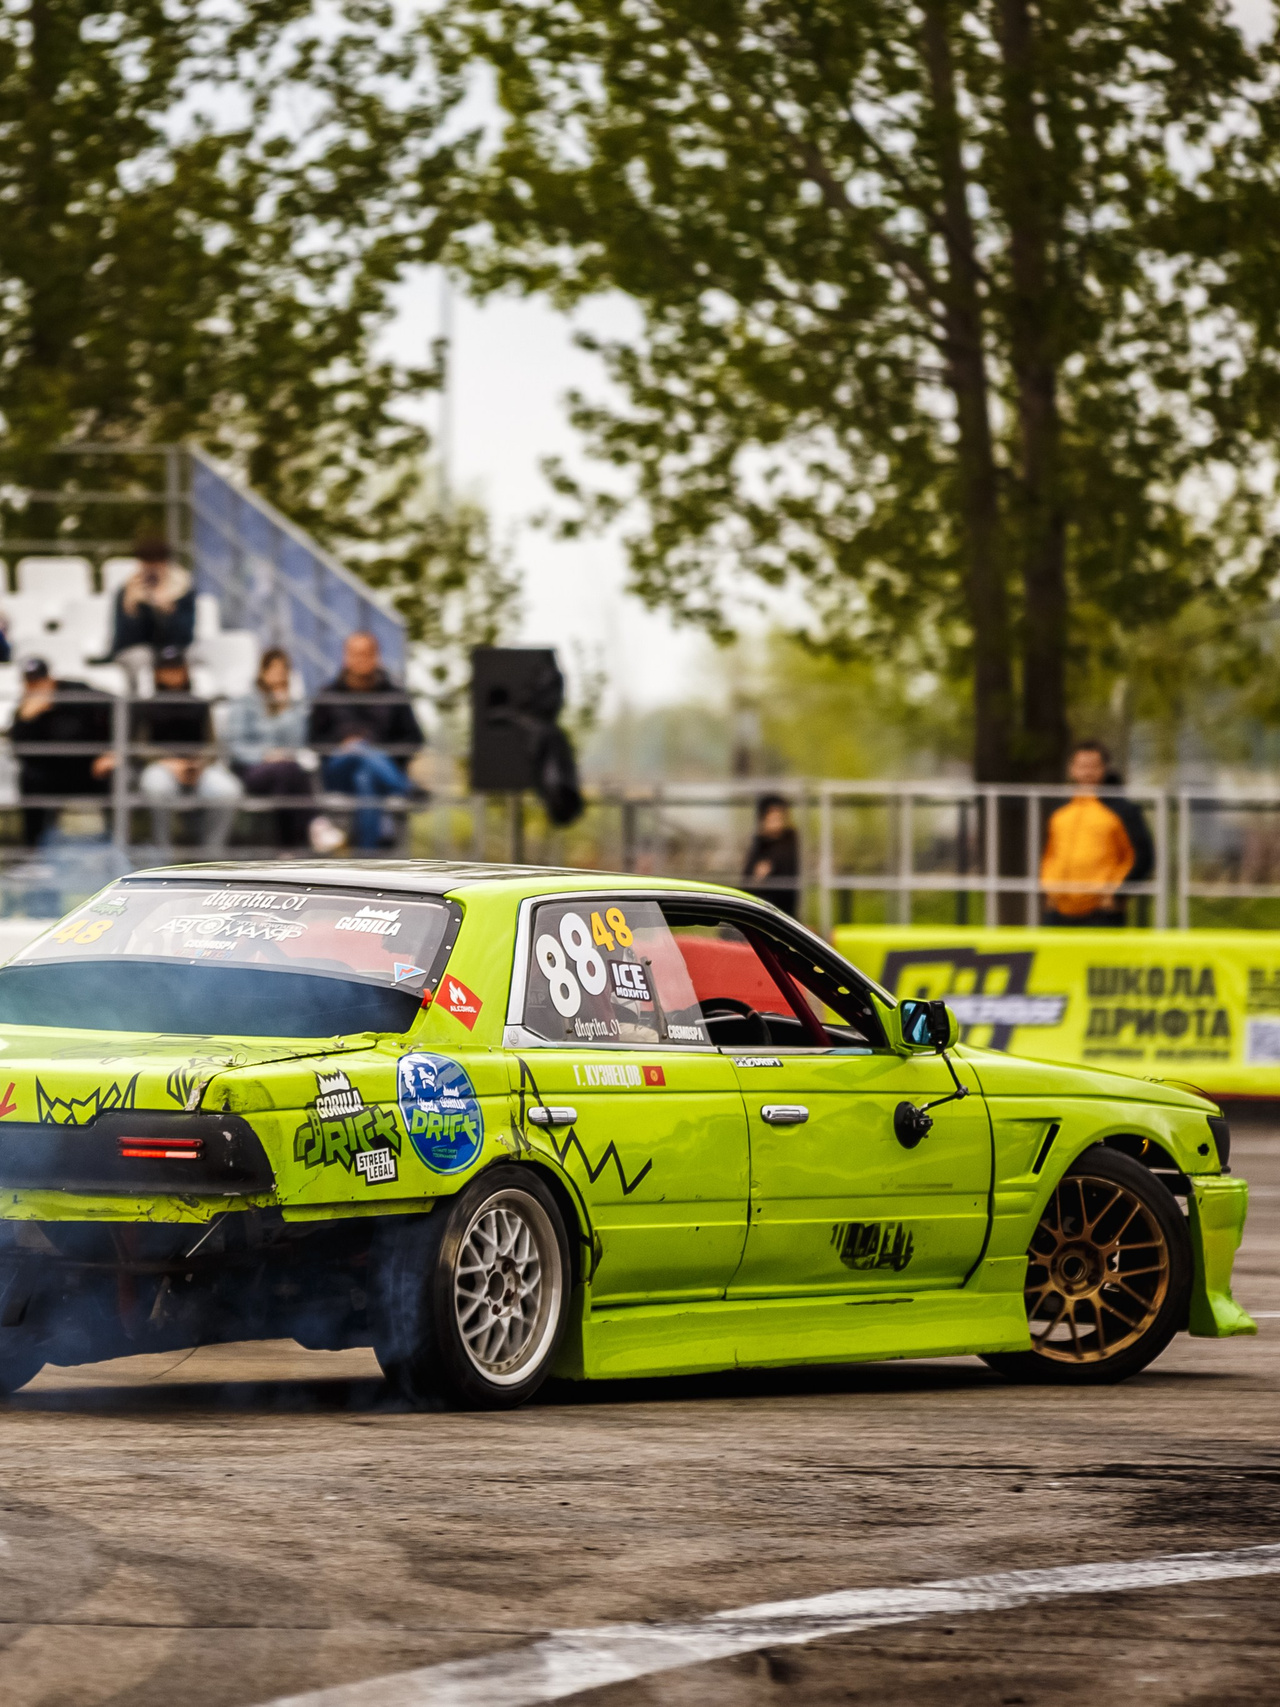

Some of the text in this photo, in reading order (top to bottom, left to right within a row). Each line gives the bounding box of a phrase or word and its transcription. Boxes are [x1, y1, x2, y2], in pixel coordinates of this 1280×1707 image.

[51, 919, 114, 945] 48
[335, 916, 402, 936] GORILLA
[591, 907, 634, 952] 48
[535, 912, 607, 1018] 88
[611, 962, 648, 990] ICE
[616, 986, 650, 1001] МОХИТО
[1087, 967, 1216, 997] ШКОЛА
[449, 1005, 477, 1014] ALCOHOL
[1085, 1008, 1230, 1038] ДРИФТА
[573, 1064, 642, 1088] Г. КУЗНЕЦОВ
[315, 1090, 364, 1119] GORILLA
[439, 1096, 467, 1110] GORILLA
[410, 1108, 478, 1146] DRIFT
[359, 1150, 388, 1168] STREET
[368, 1162, 394, 1179] LEGAL
